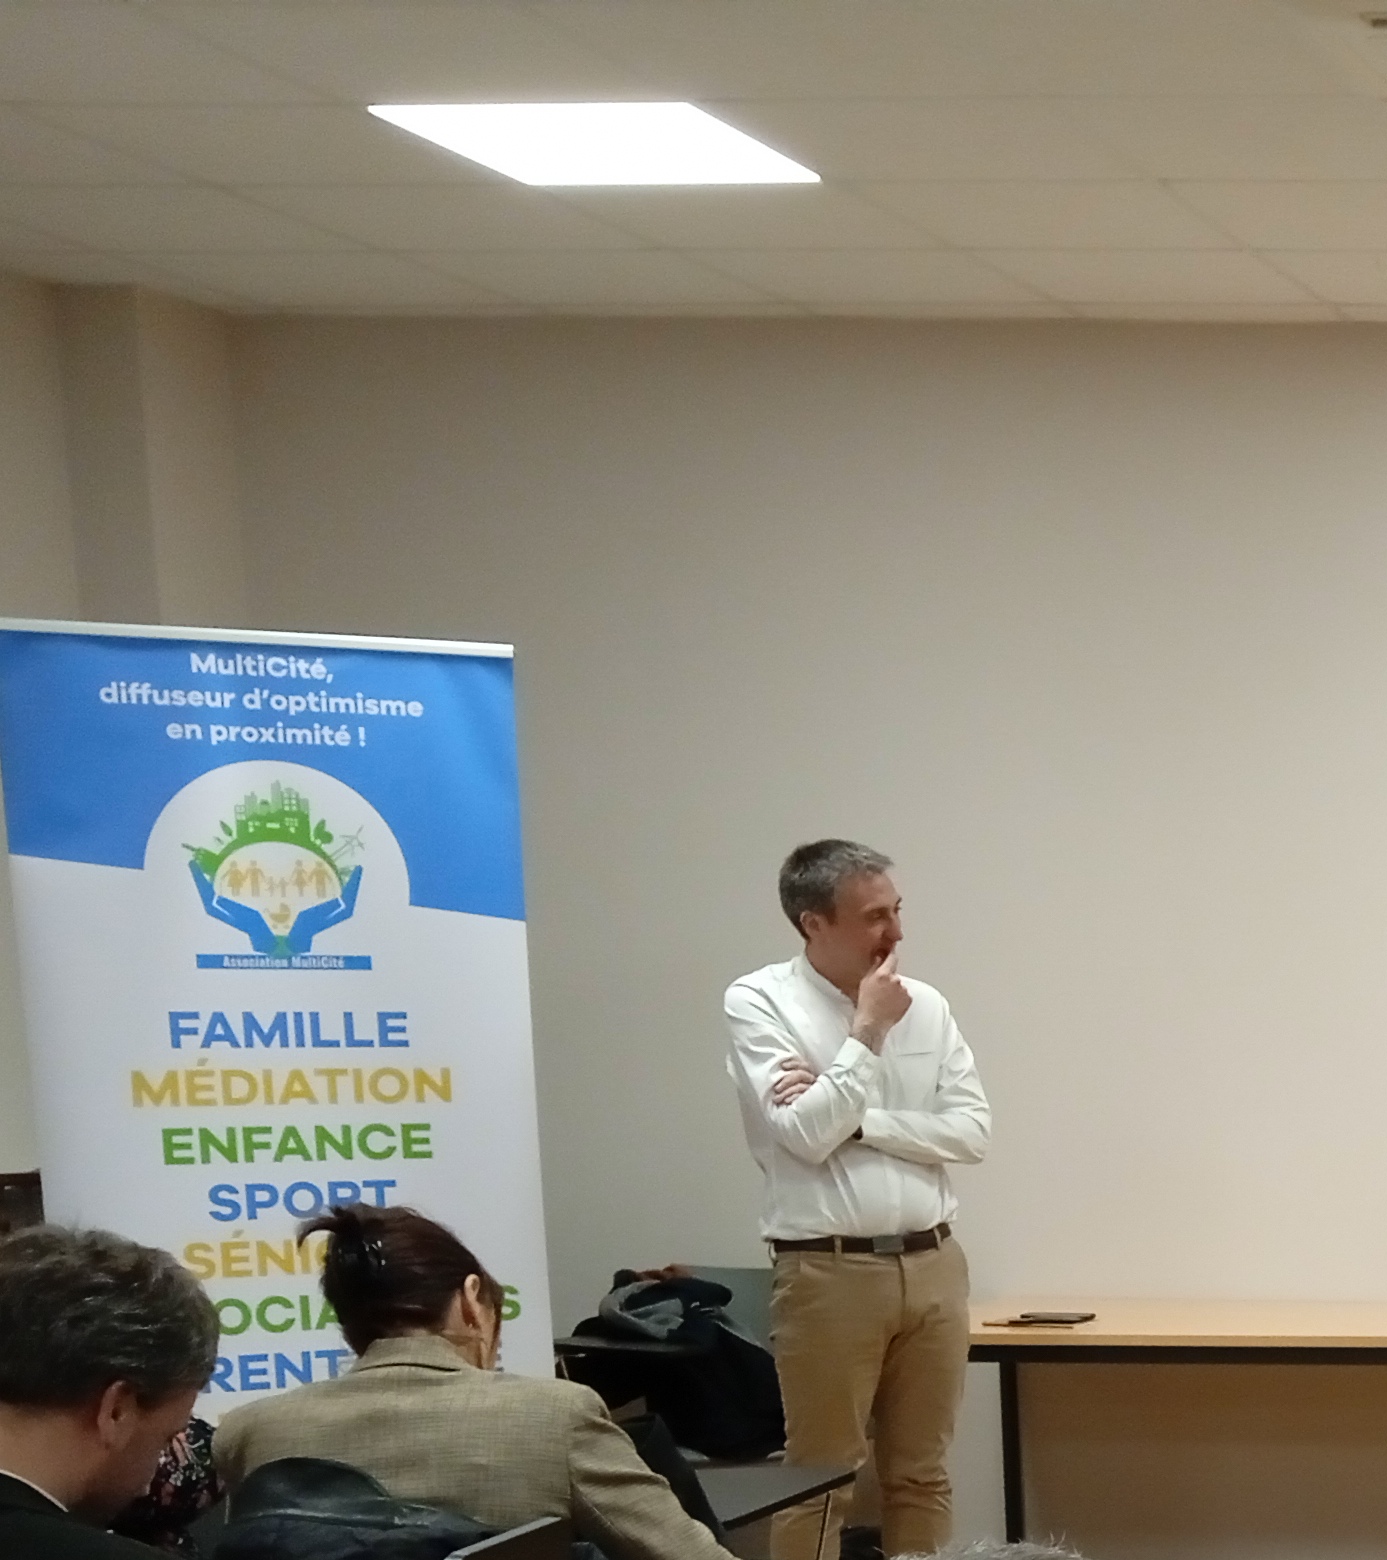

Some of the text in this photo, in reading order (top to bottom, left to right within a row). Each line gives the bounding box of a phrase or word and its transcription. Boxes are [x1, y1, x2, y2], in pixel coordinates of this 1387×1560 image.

[190, 653, 333, 683] MultiCité,
[99, 681, 423, 718] diffuseur d'optimisme
[166, 722, 366, 748] en proximité !
[223, 955, 345, 969] Association MultiCité
[168, 1011, 410, 1049] FAMILLE
[130, 1058, 453, 1108] MÉDIATION
[162, 1123, 434, 1166] ENFANCE
